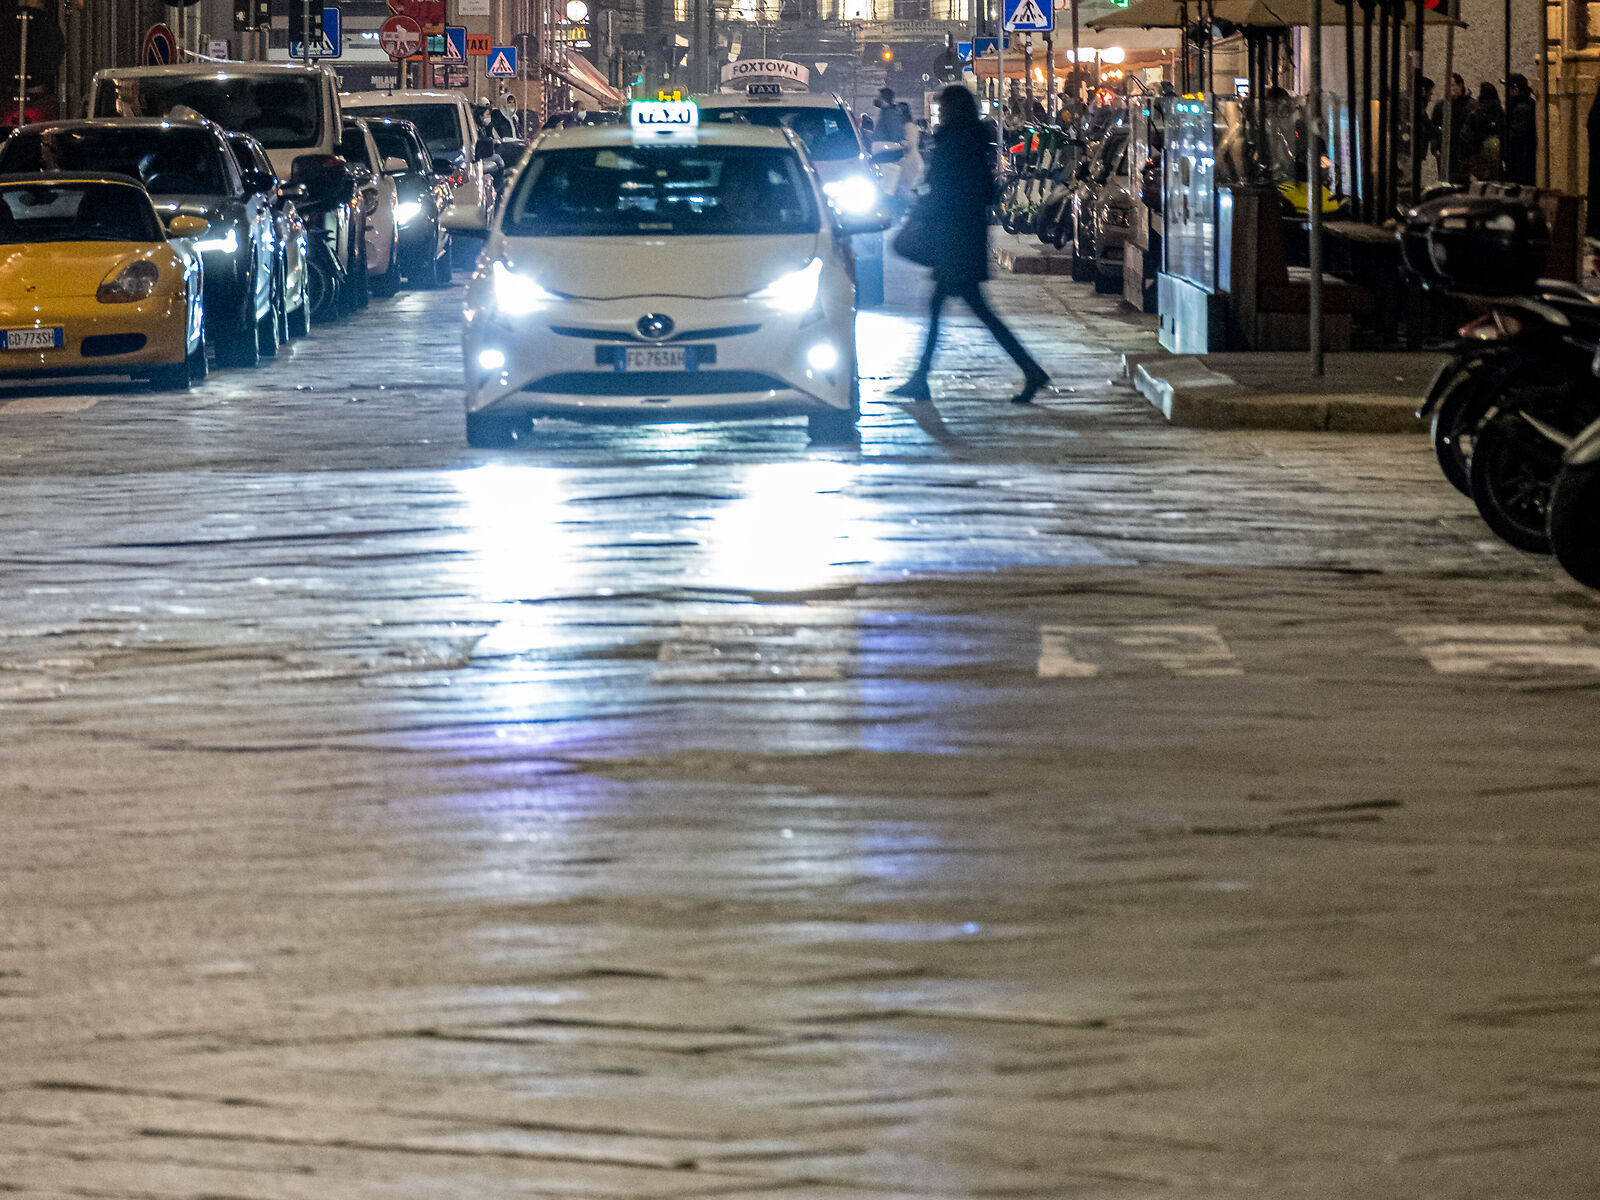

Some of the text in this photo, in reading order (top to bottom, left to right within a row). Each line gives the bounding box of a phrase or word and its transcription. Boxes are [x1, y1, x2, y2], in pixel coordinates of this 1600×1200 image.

[732, 61, 799, 77] FOXTOWN
[750, 84, 779, 94] TAXI
[638, 108, 690, 124] TAXI
